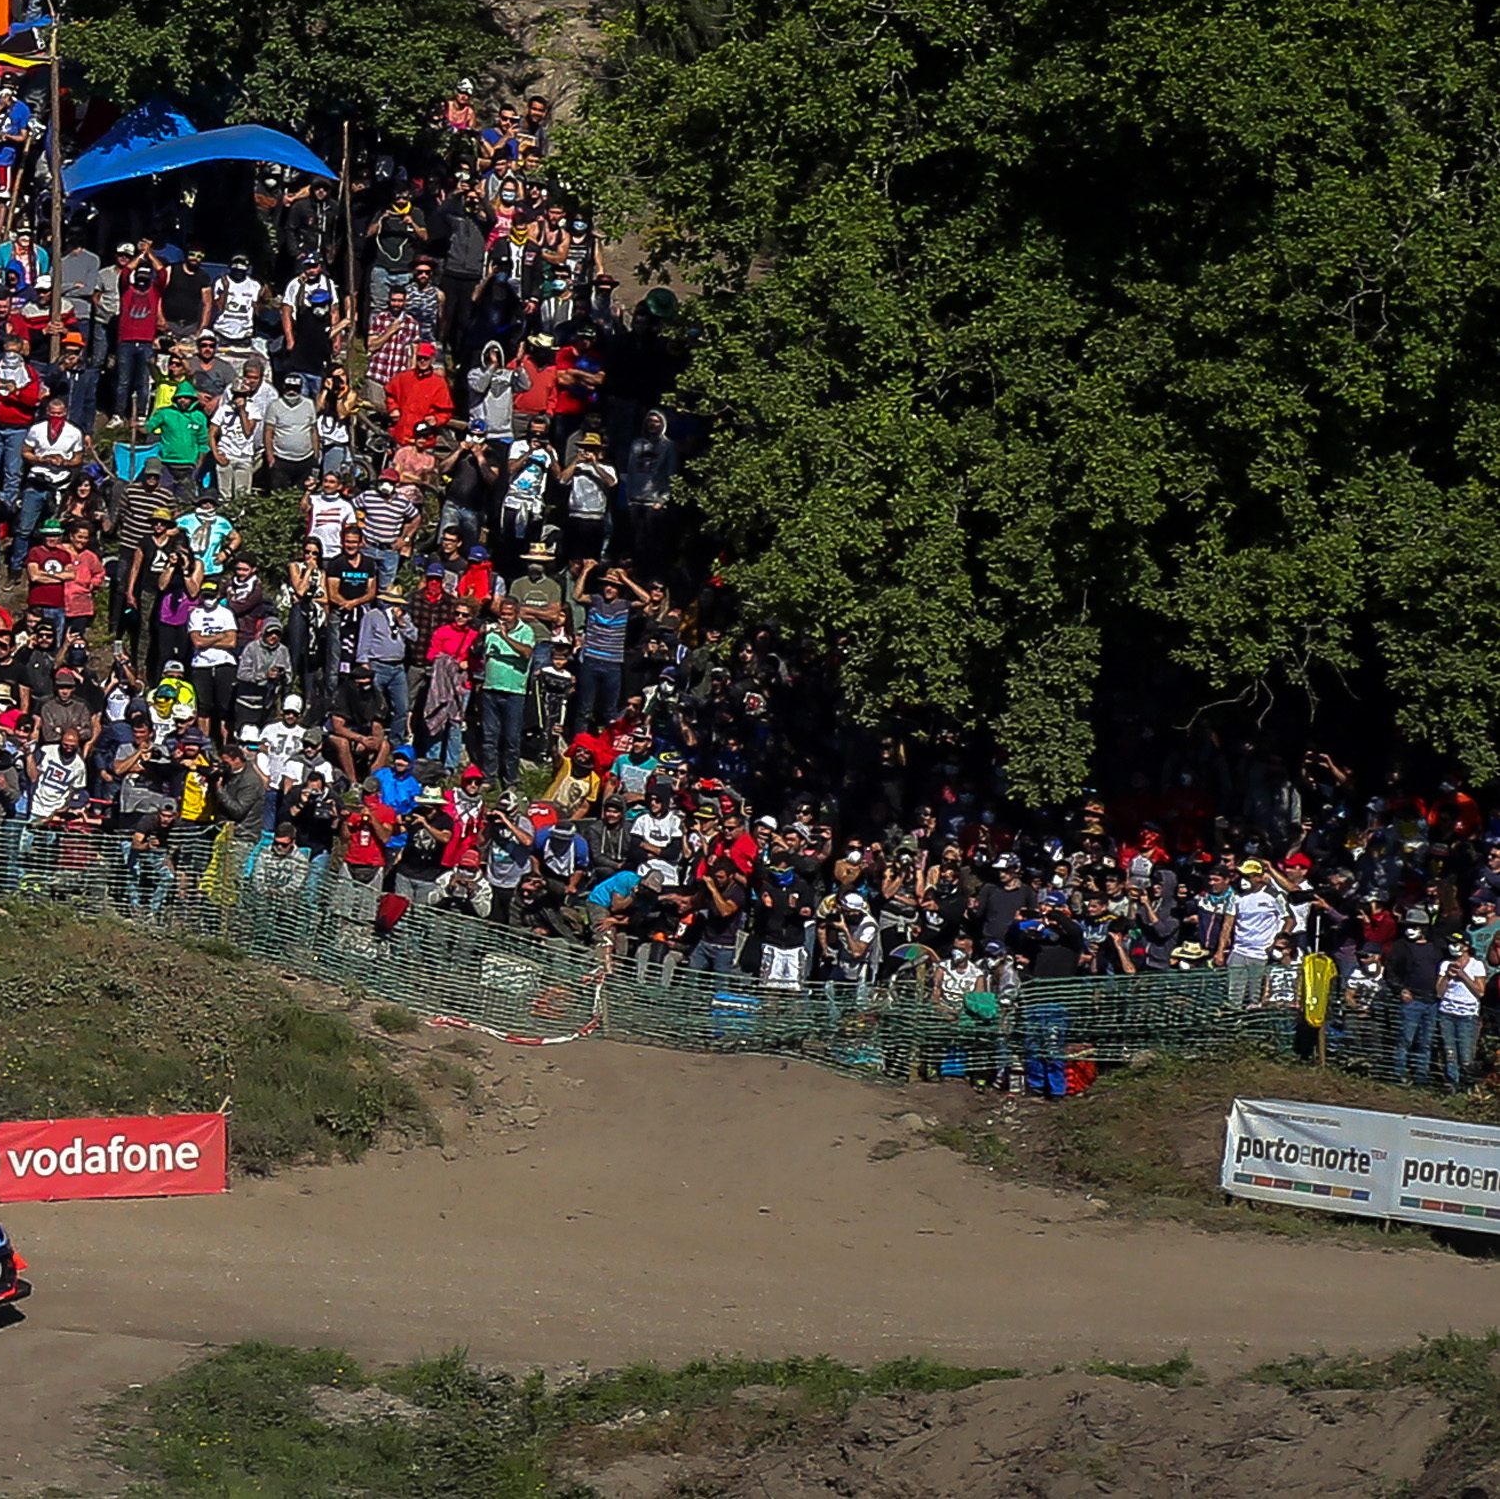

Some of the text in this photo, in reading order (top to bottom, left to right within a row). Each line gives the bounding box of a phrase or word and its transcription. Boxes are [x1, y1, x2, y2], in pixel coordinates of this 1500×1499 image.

[7, 1135, 200, 1179] vodafone
[1235, 1135, 1371, 1175] portoenorte
[1401, 1159, 1500, 1192] portoen
